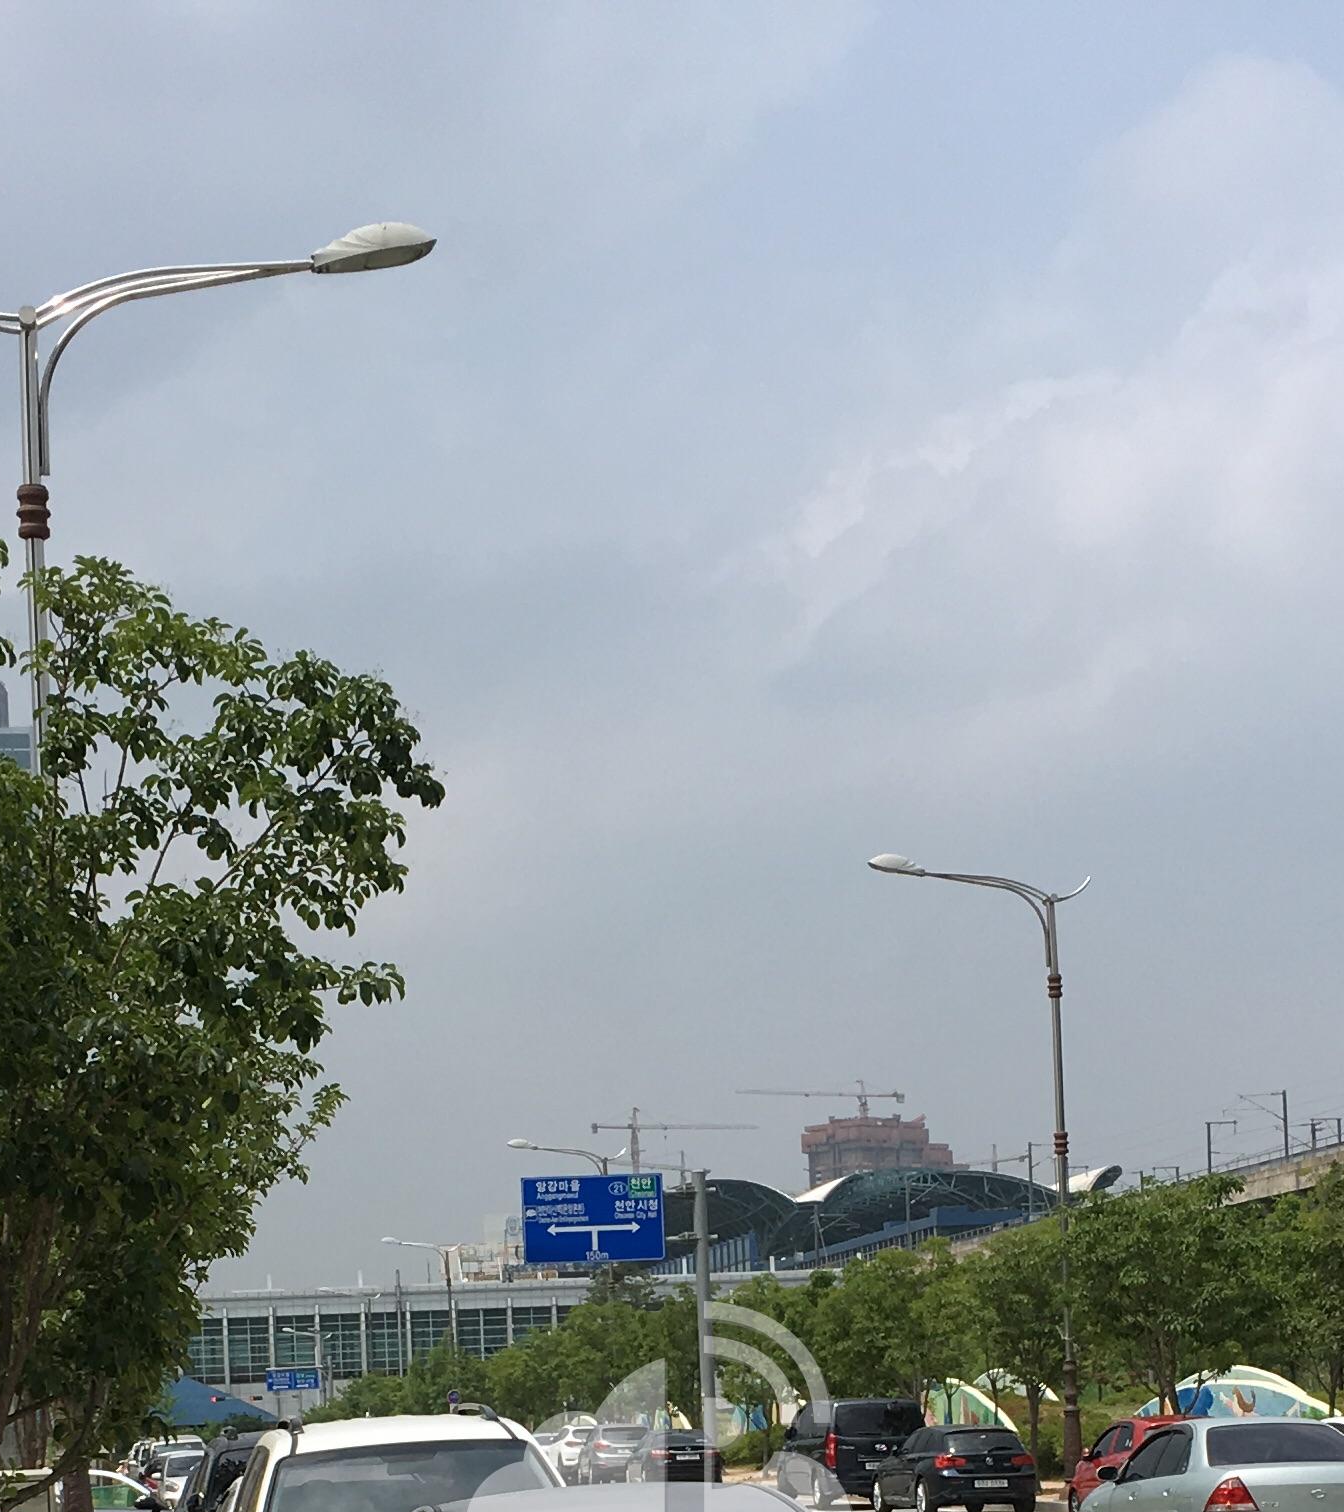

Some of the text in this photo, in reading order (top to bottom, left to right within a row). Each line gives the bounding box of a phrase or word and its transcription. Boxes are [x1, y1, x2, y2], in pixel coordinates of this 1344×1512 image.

[613, 1184, 624, 1194] 21
[630, 1177, 652, 1190] 천안
[585, 1250, 609, 1261] 150m
